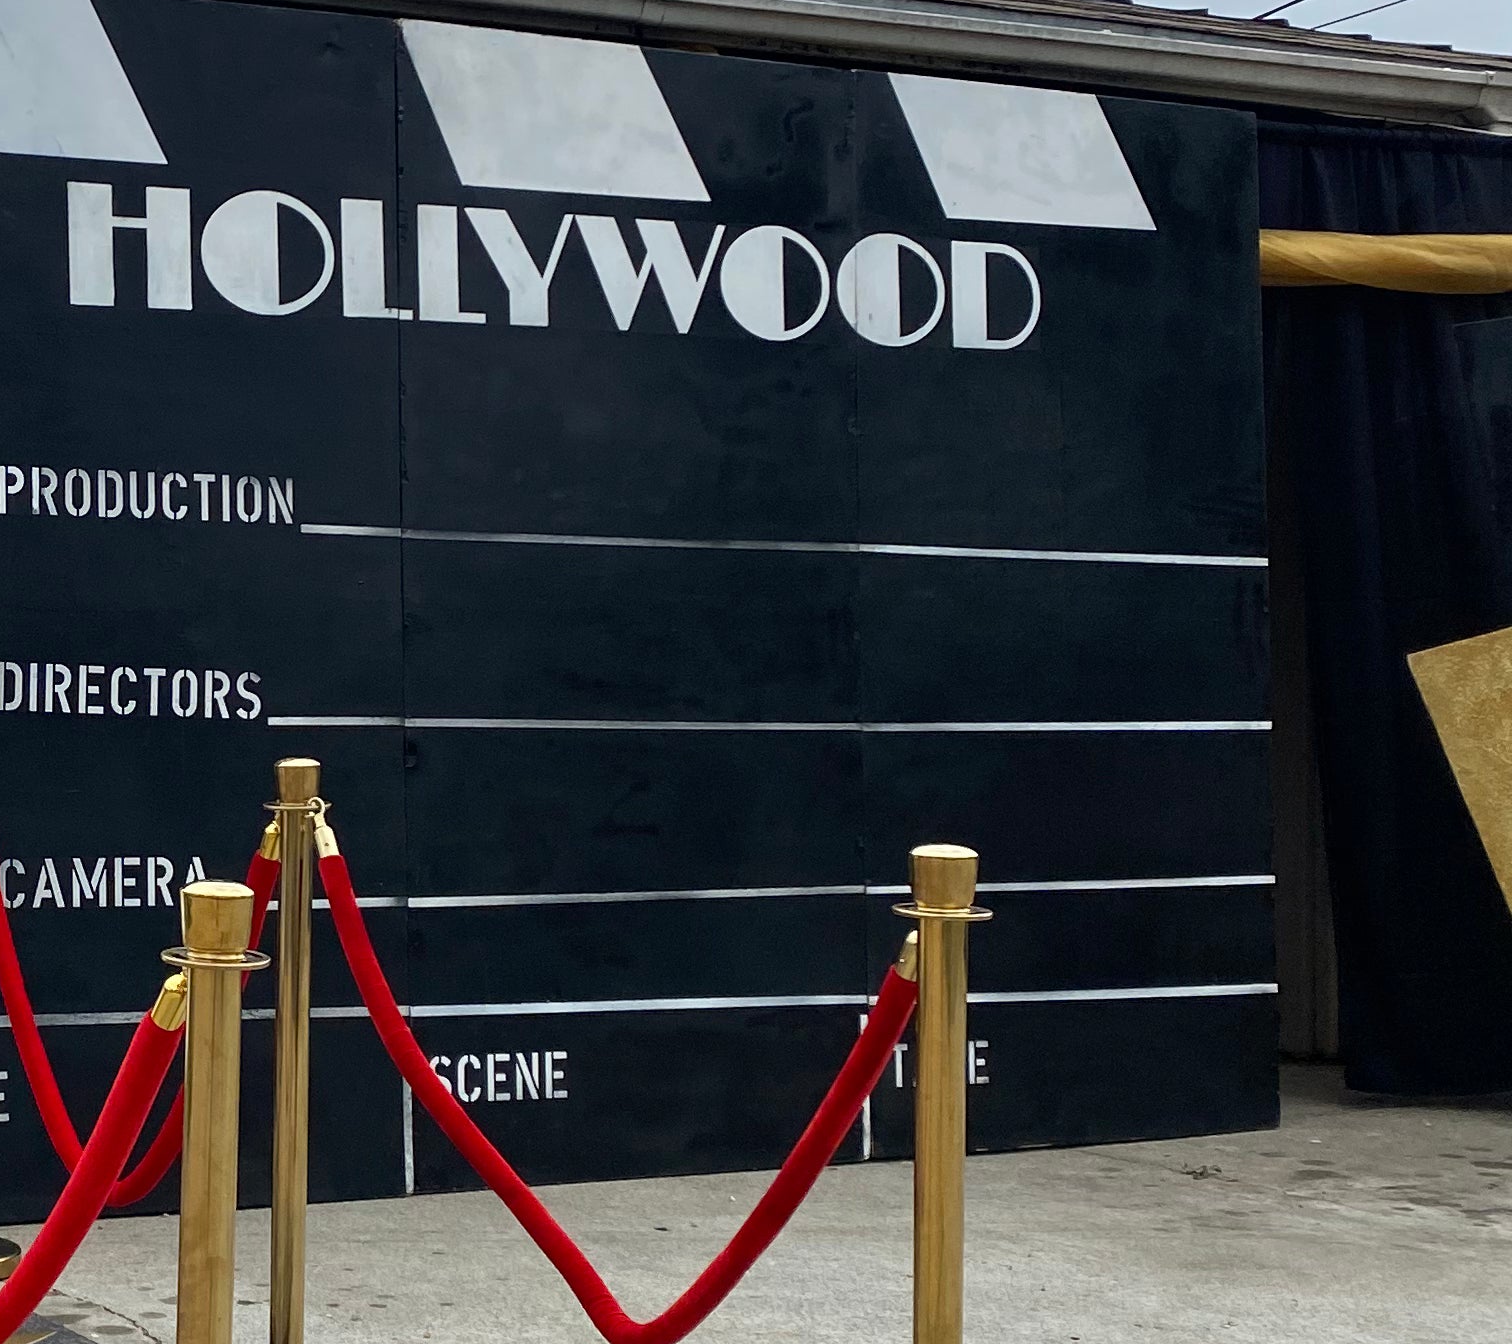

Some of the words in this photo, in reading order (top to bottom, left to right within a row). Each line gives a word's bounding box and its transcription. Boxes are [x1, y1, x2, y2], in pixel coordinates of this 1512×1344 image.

[67, 181, 1041, 350] HOLLYWOOD
[429, 1050, 569, 1103] SCENE
[893, 1039, 990, 1088] TE
